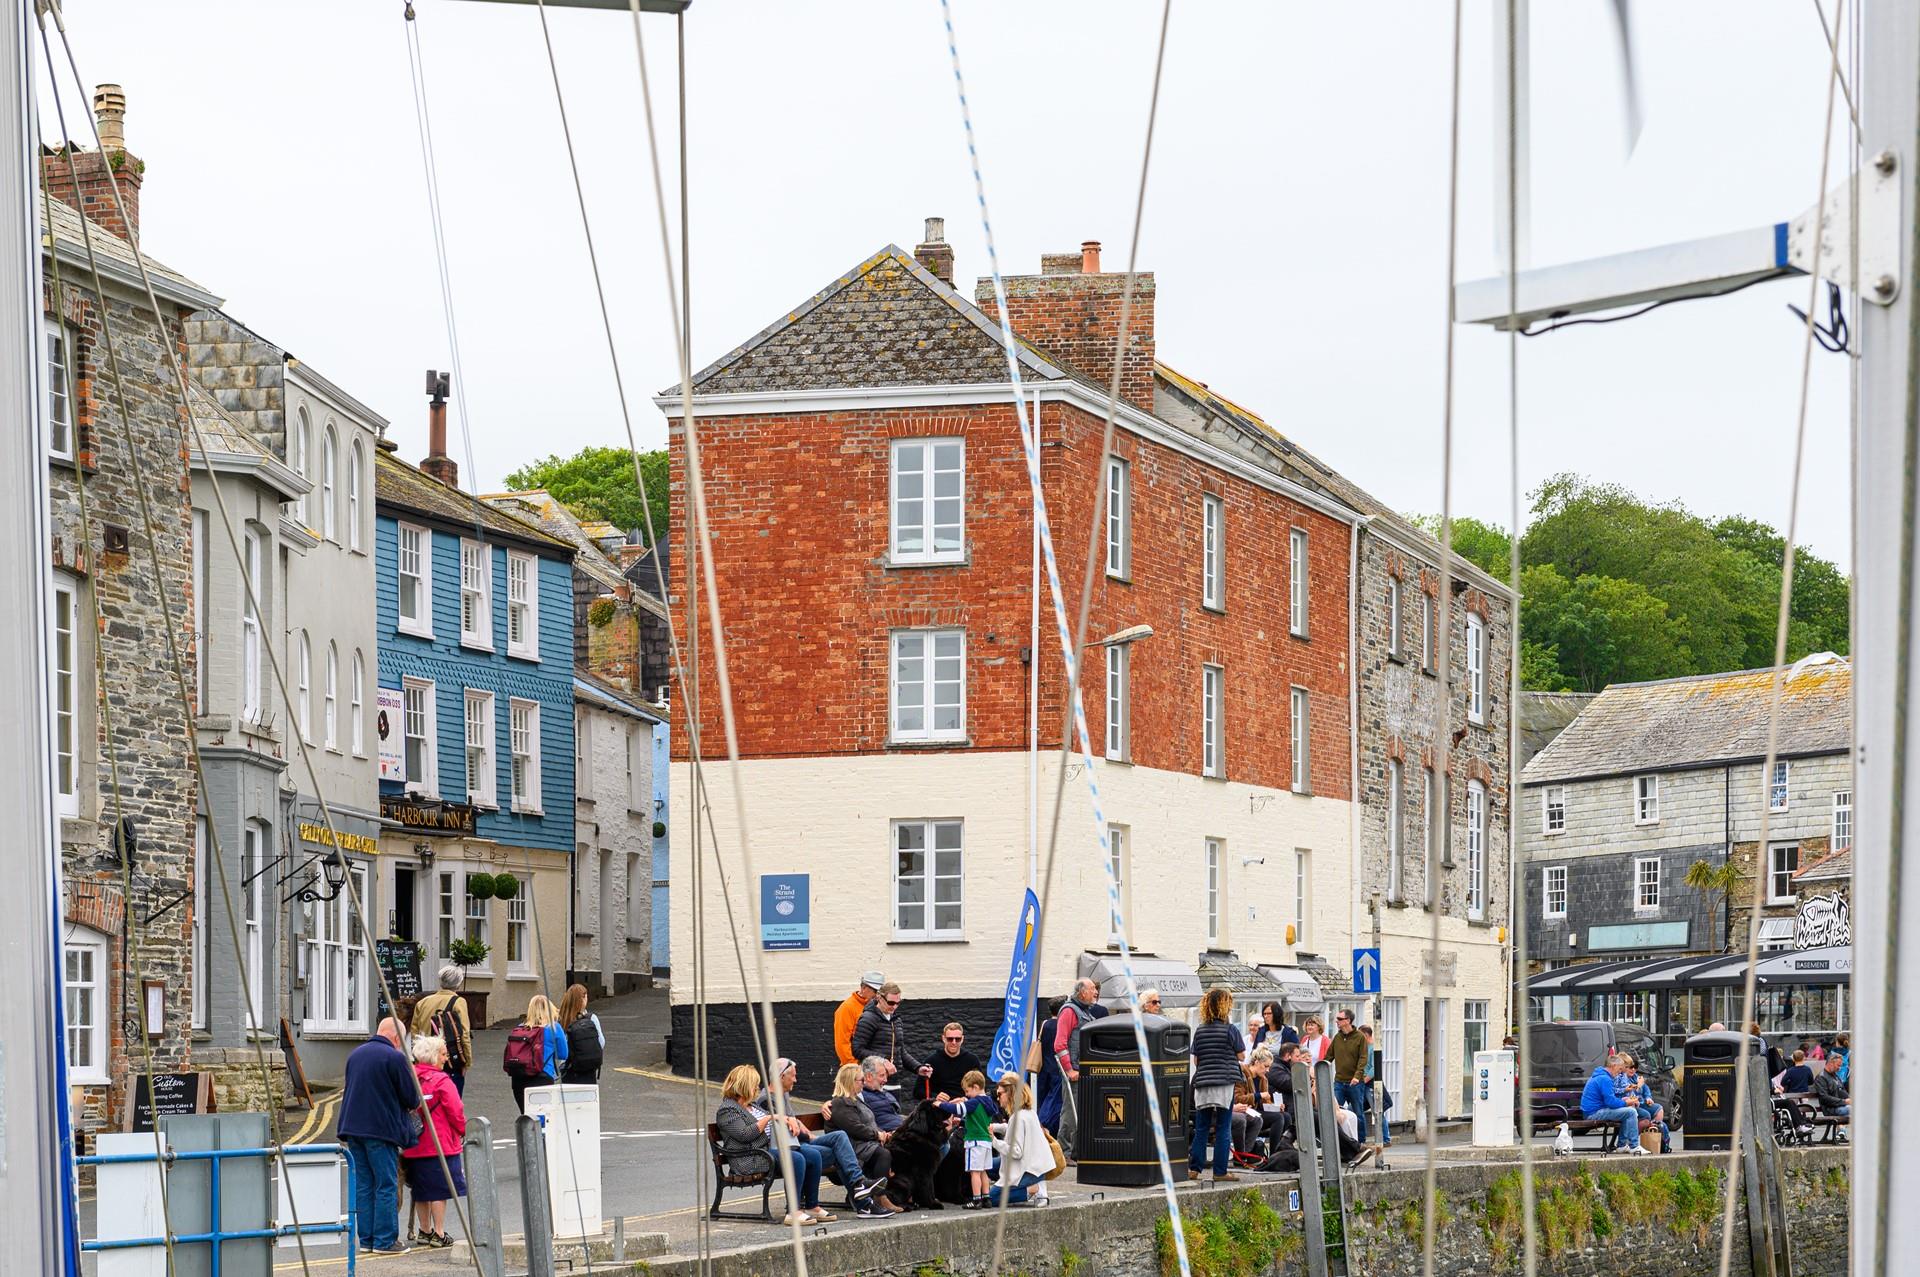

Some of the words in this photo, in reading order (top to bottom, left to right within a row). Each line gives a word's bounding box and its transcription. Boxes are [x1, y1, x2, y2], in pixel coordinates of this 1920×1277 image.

[394, 805, 438, 826] HARBOUR
[444, 812, 460, 829] INN
[1796, 961, 1828, 969] BASEMENT
[1835, 960, 1853, 969] CAF
[1159, 979, 1168, 992] ICE
[1169, 979, 1189, 992] CREAM
[152, 1075, 185, 1088] Custom
[1290, 1191, 1299, 1209] 10
